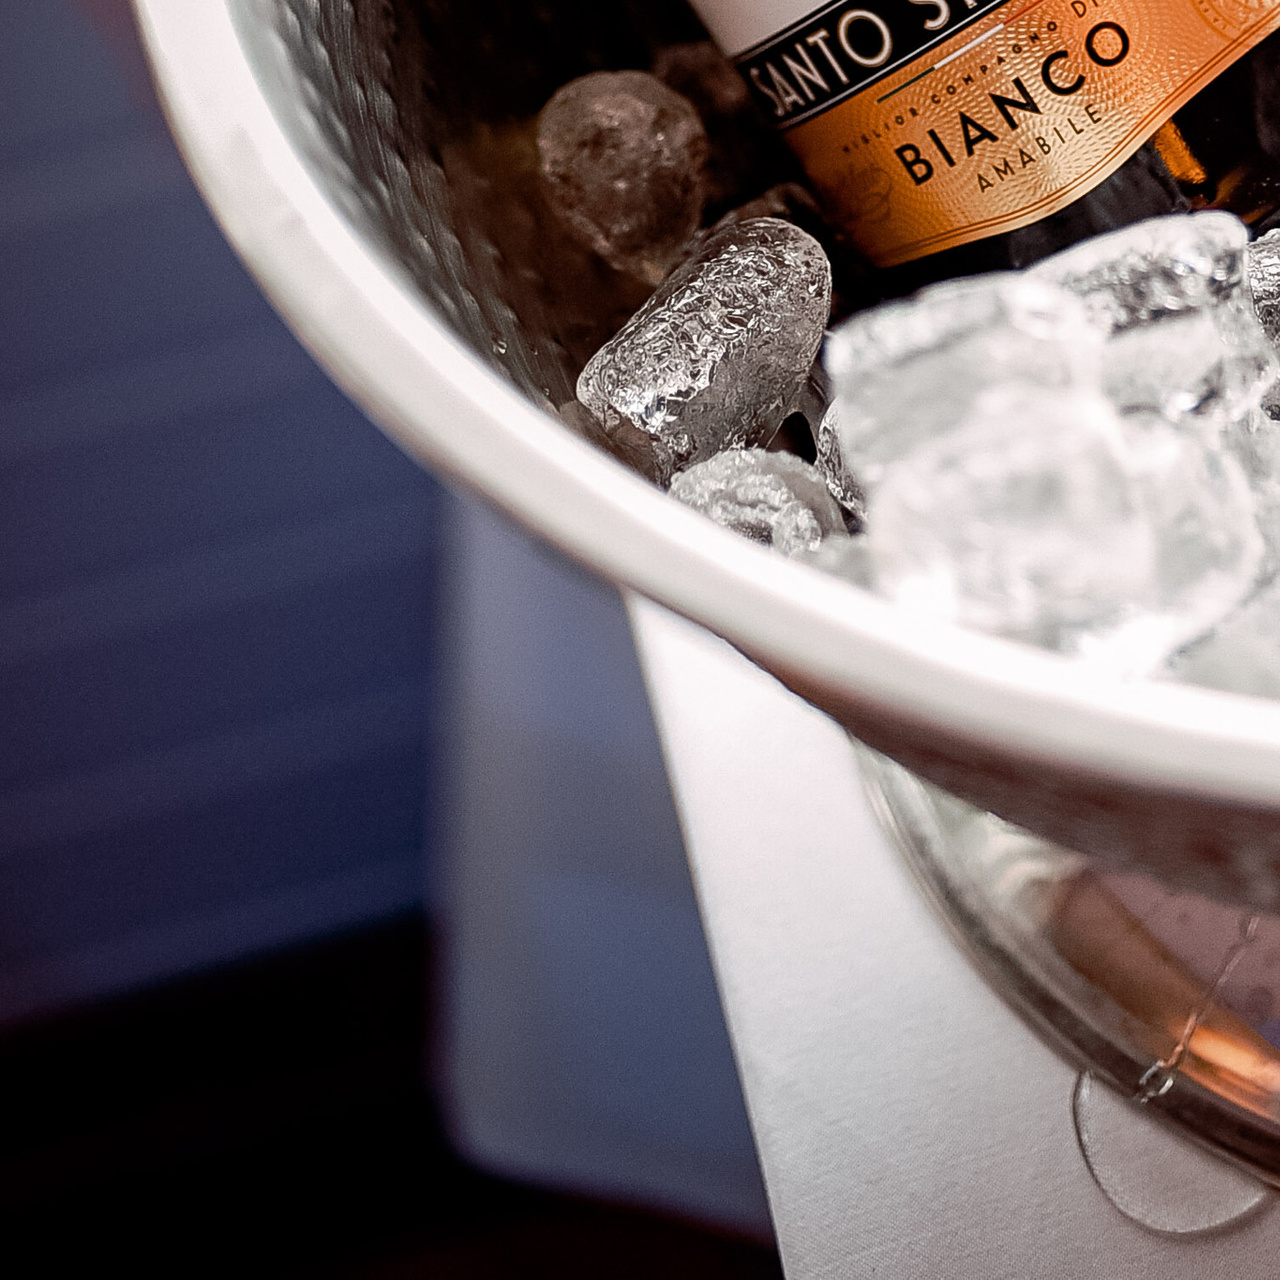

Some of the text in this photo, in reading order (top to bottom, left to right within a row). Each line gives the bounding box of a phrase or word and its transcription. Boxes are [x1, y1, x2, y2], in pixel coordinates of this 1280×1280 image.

[749, 8, 893, 117] SANTO
[894, 20, 1130, 187] BIANCO
[930, 20, 1058, 106] COMPAGNO
[976, 103, 1102, 194] AMABILE
